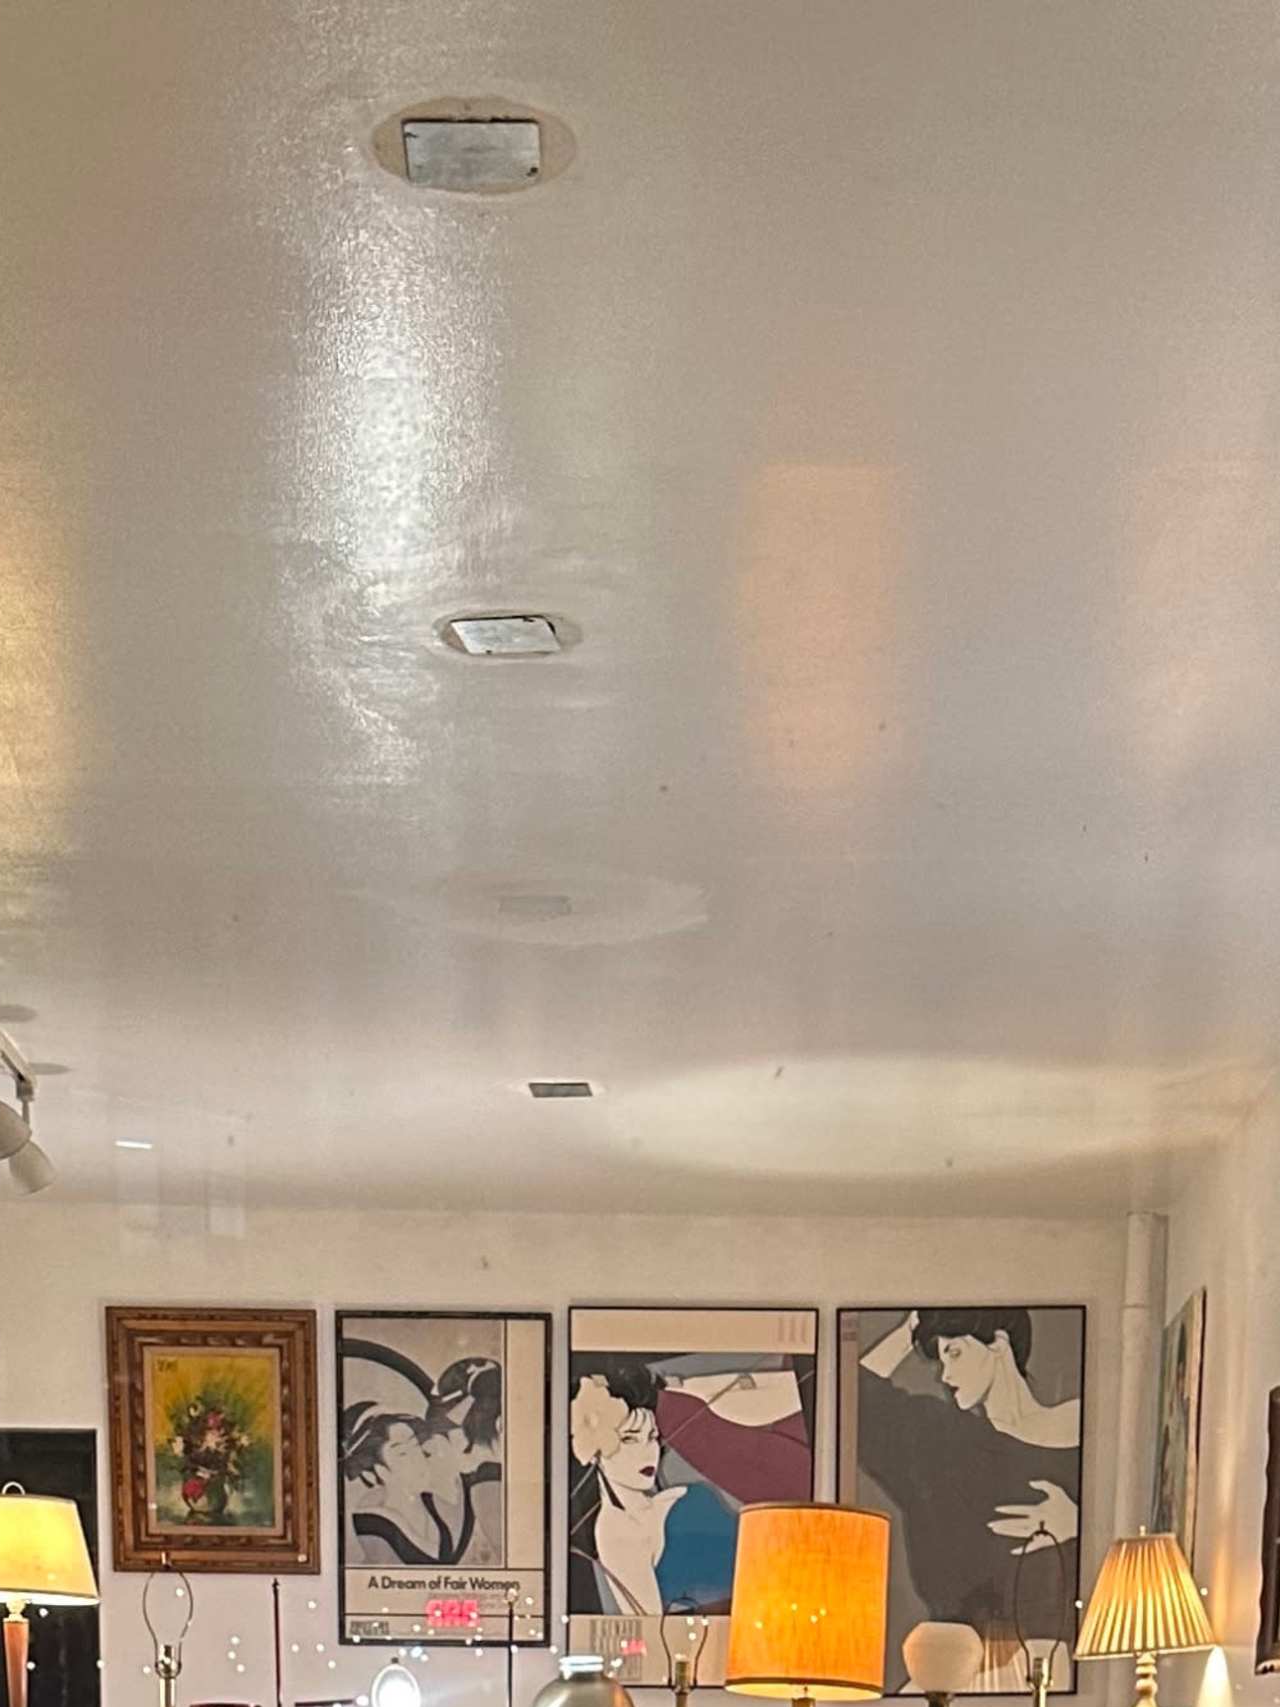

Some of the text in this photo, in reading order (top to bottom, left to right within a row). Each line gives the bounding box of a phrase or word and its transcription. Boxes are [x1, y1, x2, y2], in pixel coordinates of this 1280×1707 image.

[368, 1577, 521, 1591] A Dream of Fair Women
